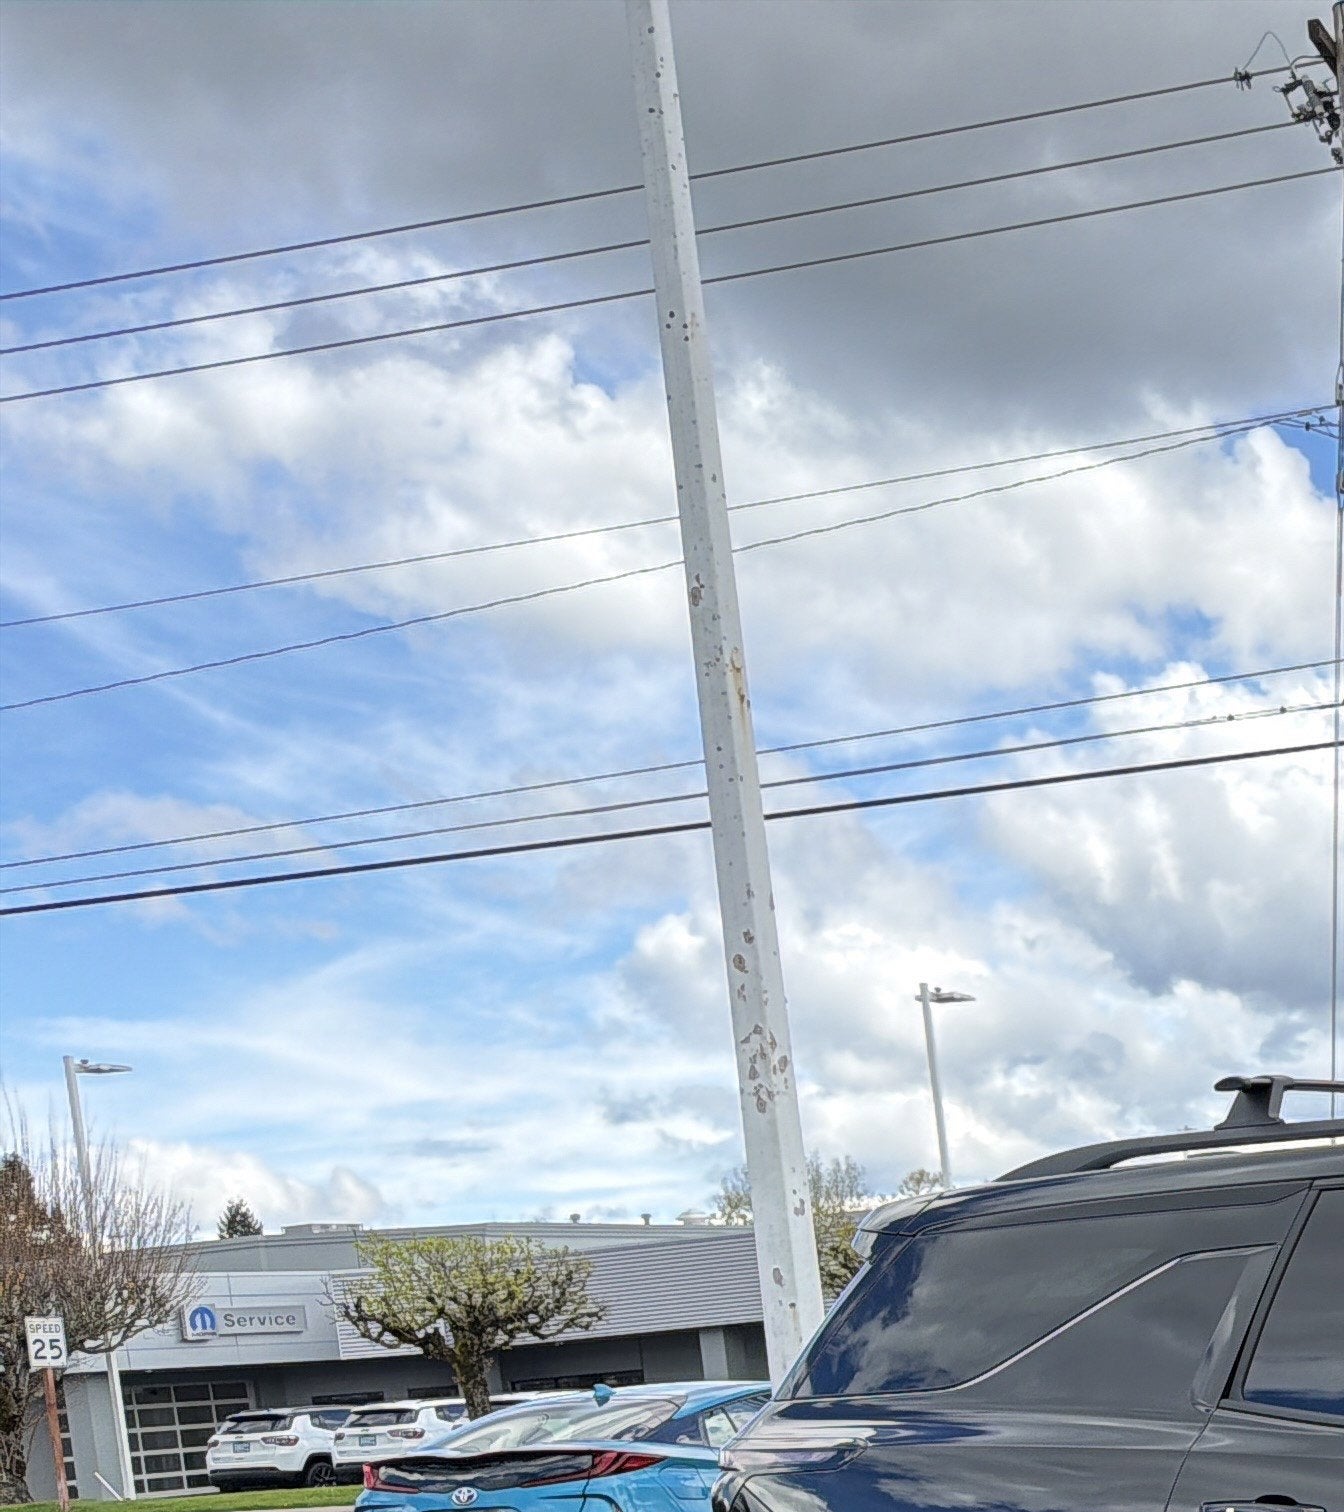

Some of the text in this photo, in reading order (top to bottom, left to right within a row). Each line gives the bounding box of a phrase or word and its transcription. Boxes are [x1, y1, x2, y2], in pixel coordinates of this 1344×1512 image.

[28, 1322, 61, 1334] SPEED
[223, 1313, 297, 1328] Service
[33, 1338, 63, 1361] 25
